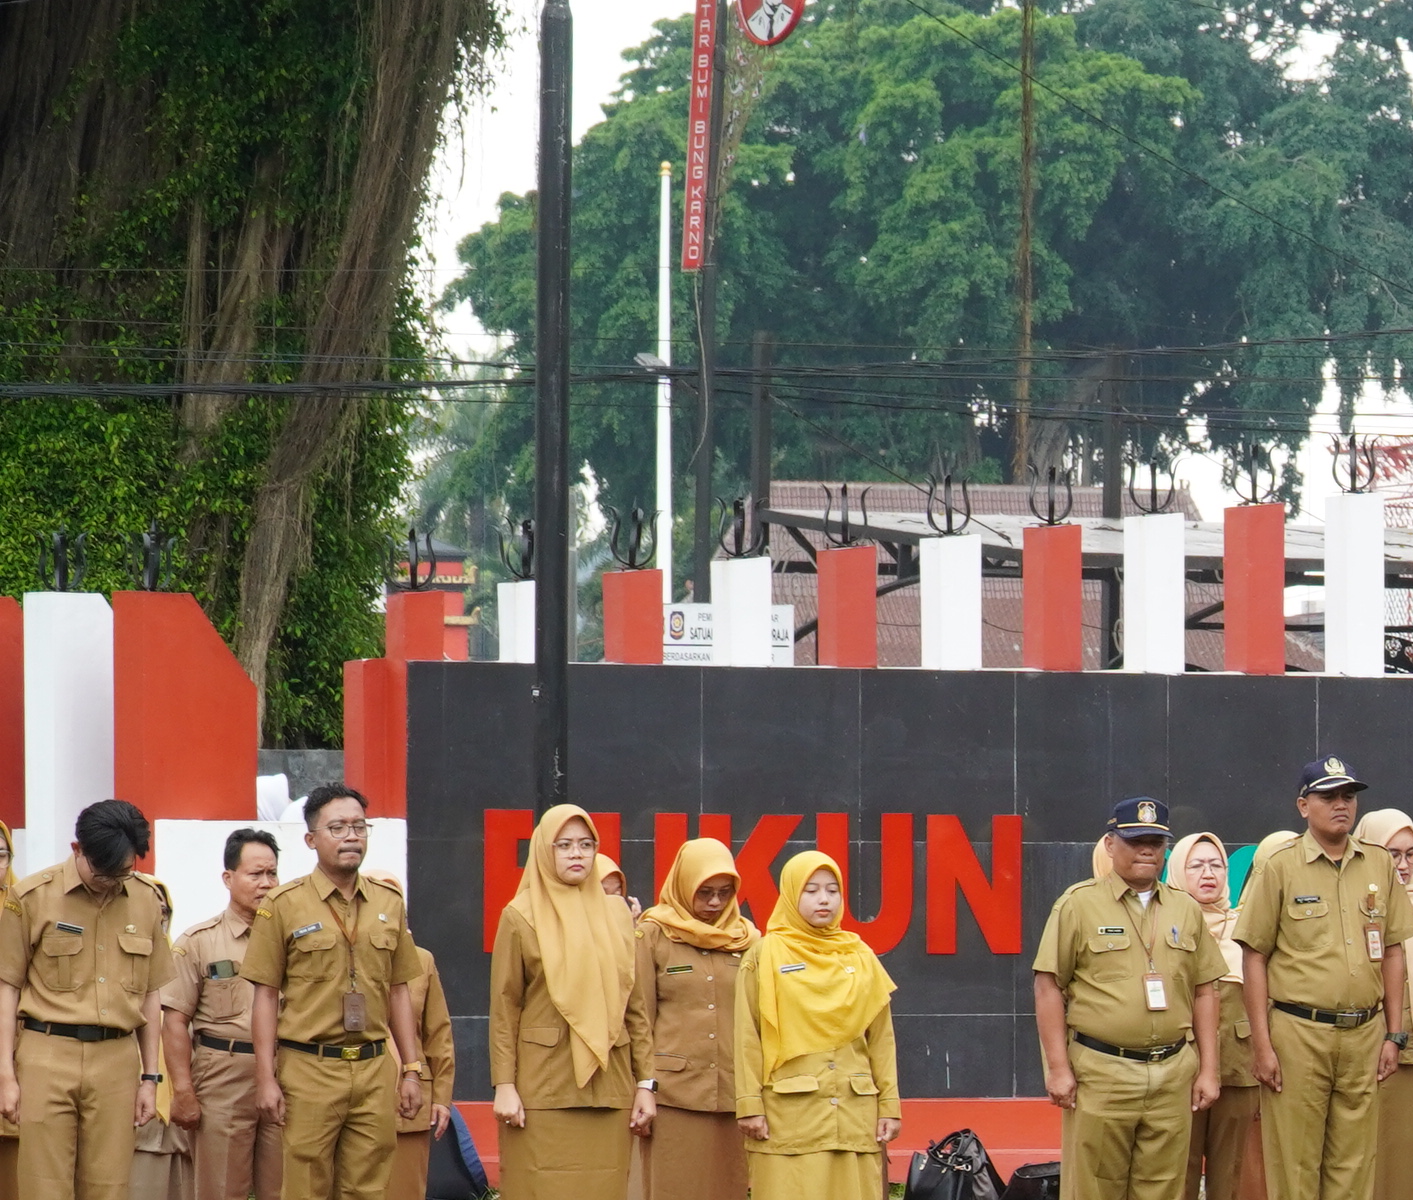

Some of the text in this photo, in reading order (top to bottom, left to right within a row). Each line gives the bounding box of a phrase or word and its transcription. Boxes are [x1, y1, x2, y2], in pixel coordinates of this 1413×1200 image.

[688, 0, 712, 260] TAR BUMI BUNG KARNO
[771, 628, 790, 641] RAJA
